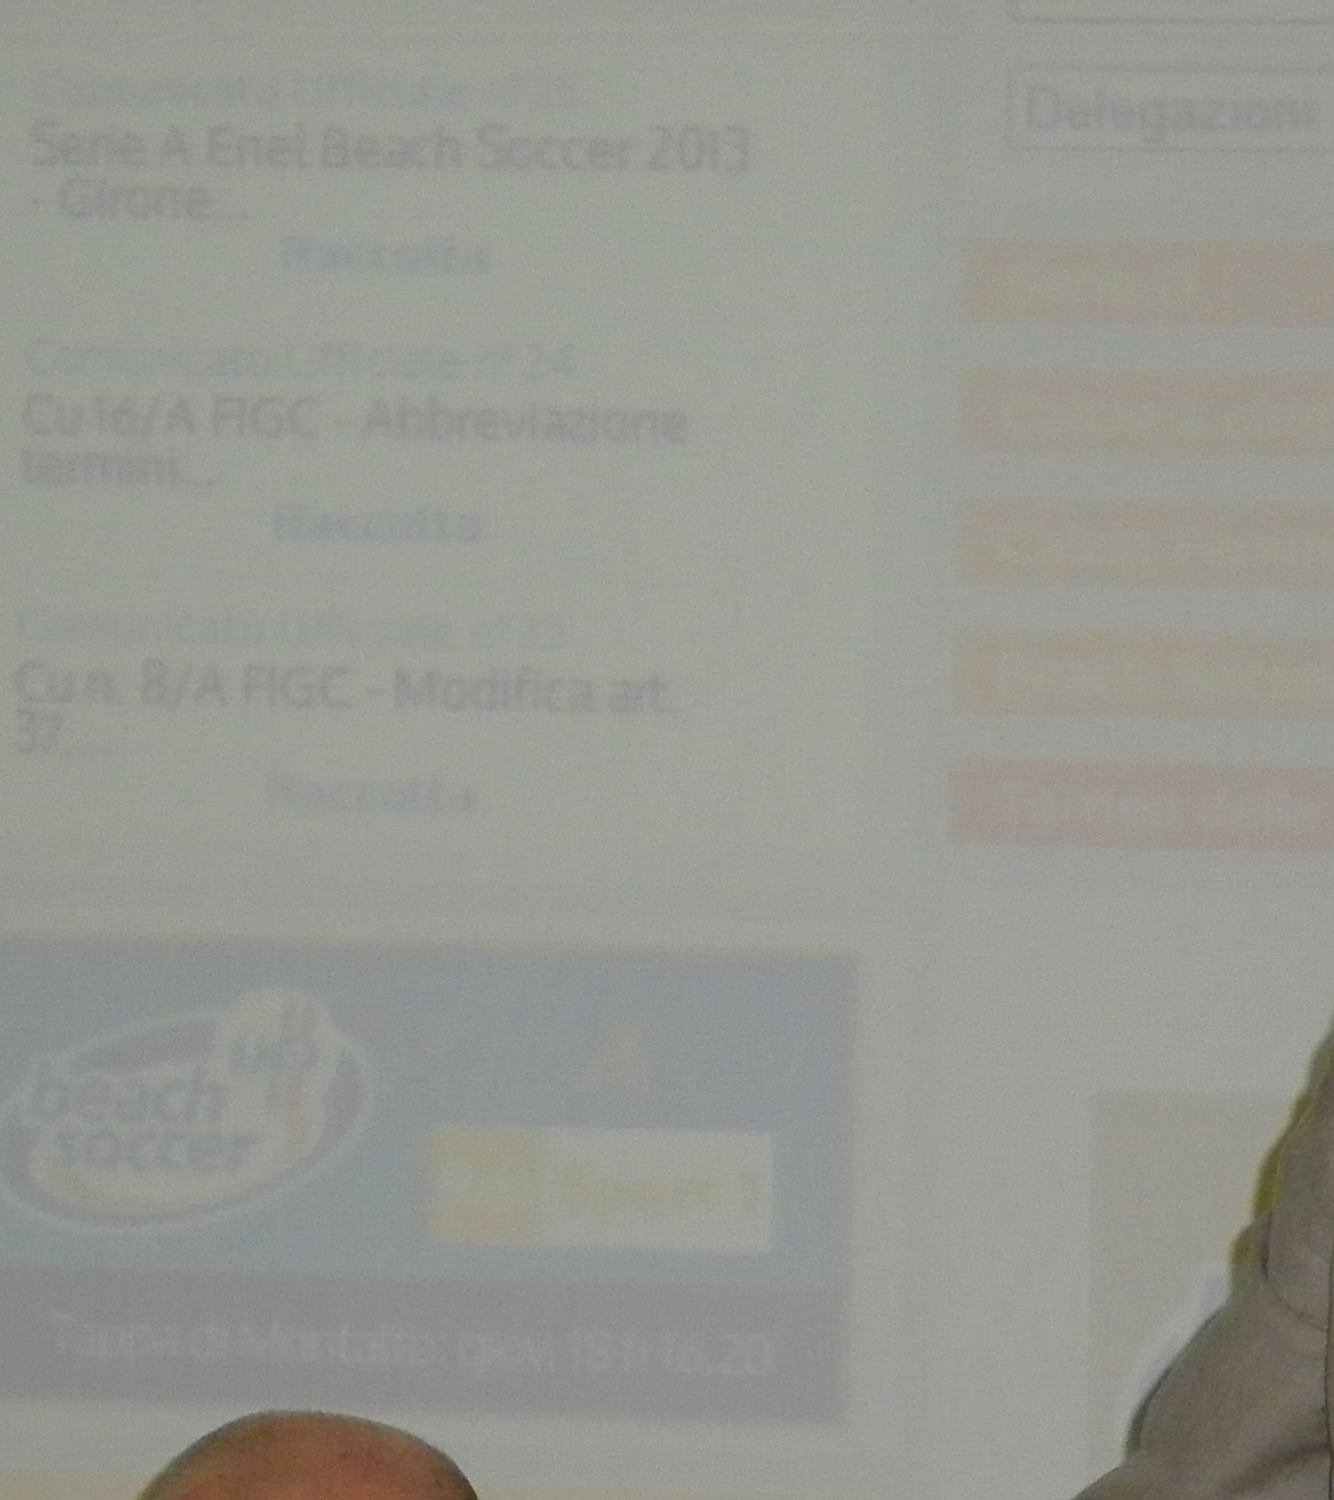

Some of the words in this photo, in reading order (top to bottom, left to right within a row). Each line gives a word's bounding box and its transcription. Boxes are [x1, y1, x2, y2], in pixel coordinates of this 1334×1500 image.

[1025, 82, 1319, 144] Delegazioni
[31, 117, 146, 168] Serie
[159, 125, 192, 168] A
[207, 121, 312, 169] Enel
[320, 123, 463, 172] Beach
[475, 121, 632, 173] Soccer
[647, 123, 752, 173] 2013
[20, 392, 81, 438] Cu
[211, 394, 320, 441] FIGC
[362, 393, 691, 445] Abbreviazione
[12, 658, 75, 706] Cu
[138, 656, 228, 715] 8/A
[241, 663, 351, 711] FIGC
[392, 662, 596, 715] Modifica
[607, 668, 682, 716] art.
[32, 1061, 226, 1124] beach
[55, 1125, 259, 1176] soccer
[53, 1312, 179, 1366] Tappa
